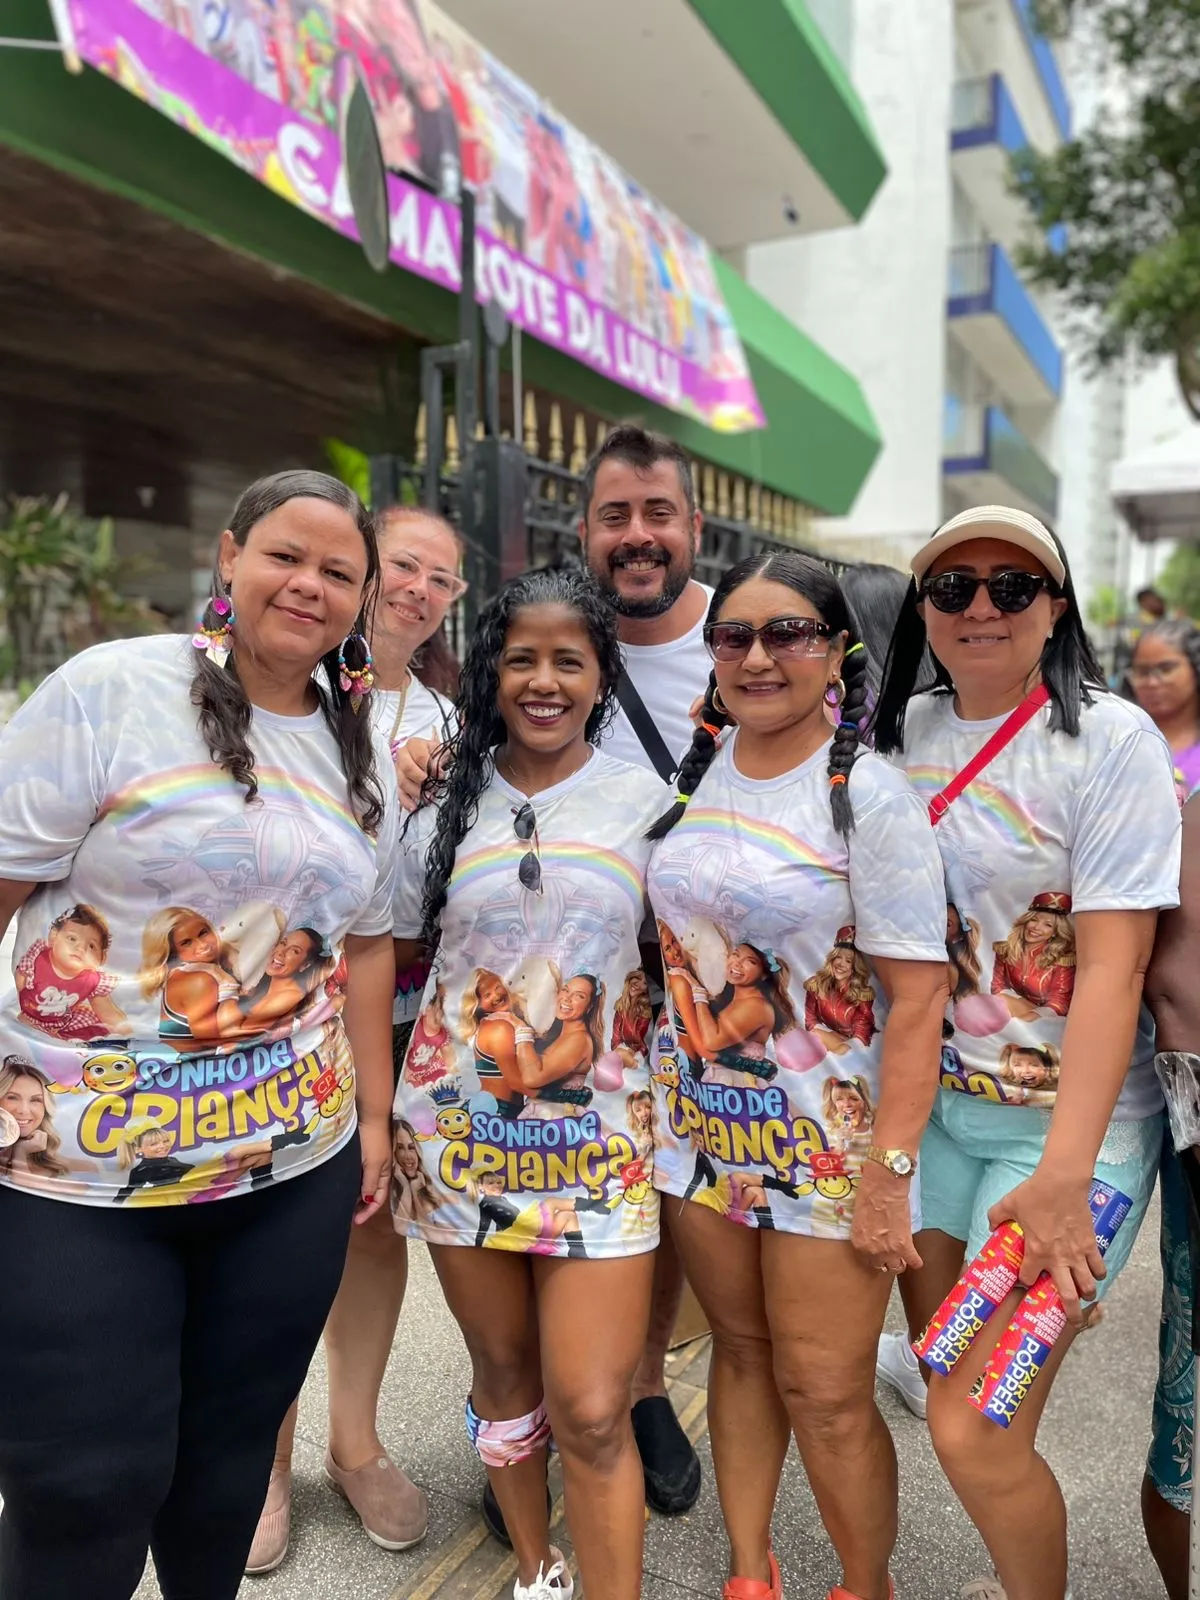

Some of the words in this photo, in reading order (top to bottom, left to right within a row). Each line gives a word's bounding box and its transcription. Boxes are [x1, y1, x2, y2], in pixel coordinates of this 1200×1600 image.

[565, 289, 613, 369] DA
[135, 1052, 248, 1092] SONHO
[317, 1074, 333, 1093] CP
[681, 1070, 742, 1116] SONHO
[472, 1114, 560, 1147] SONHO
[816, 1159, 838, 1170] CP
[927, 1290, 984, 1364] POPPER
[944, 1315, 985, 1374] PARTY
[987, 1336, 1041, 1416] POPPER
[1006, 1363, 1041, 1424] PARTY
